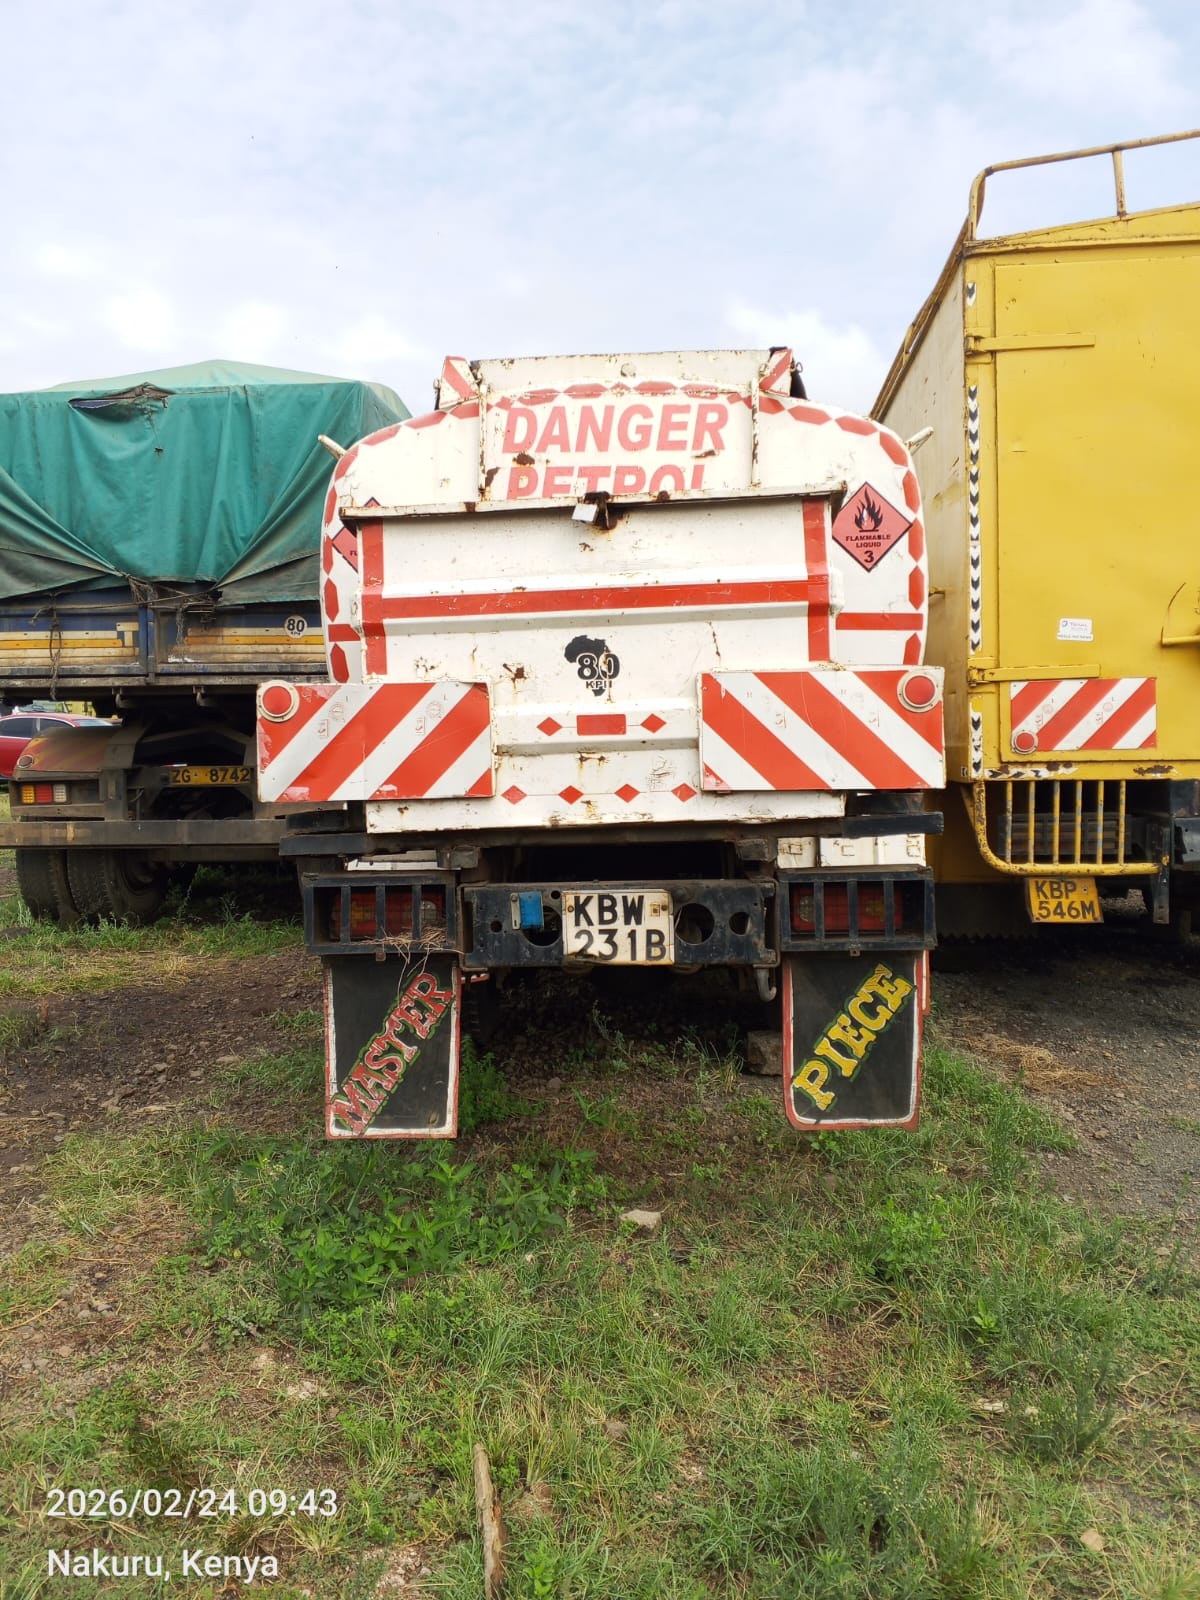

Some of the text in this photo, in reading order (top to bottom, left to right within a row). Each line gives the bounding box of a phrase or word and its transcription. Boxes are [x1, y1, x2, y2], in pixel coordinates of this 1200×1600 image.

[502, 403, 729, 453] DANGER
[863, 550, 875, 563] 3
[287, 618, 305, 632] 80
[577, 652, 621, 681] 80
[171, 767, 250, 784] ZG 8742
[1034, 879, 1078, 900] KBP
[573, 894, 645, 927] KBW
[1037, 900, 1096, 920] 546M
[574, 928, 667, 962] 231B
[792, 962, 914, 1112] PIECE
[331, 972, 455, 1136] MASTER
